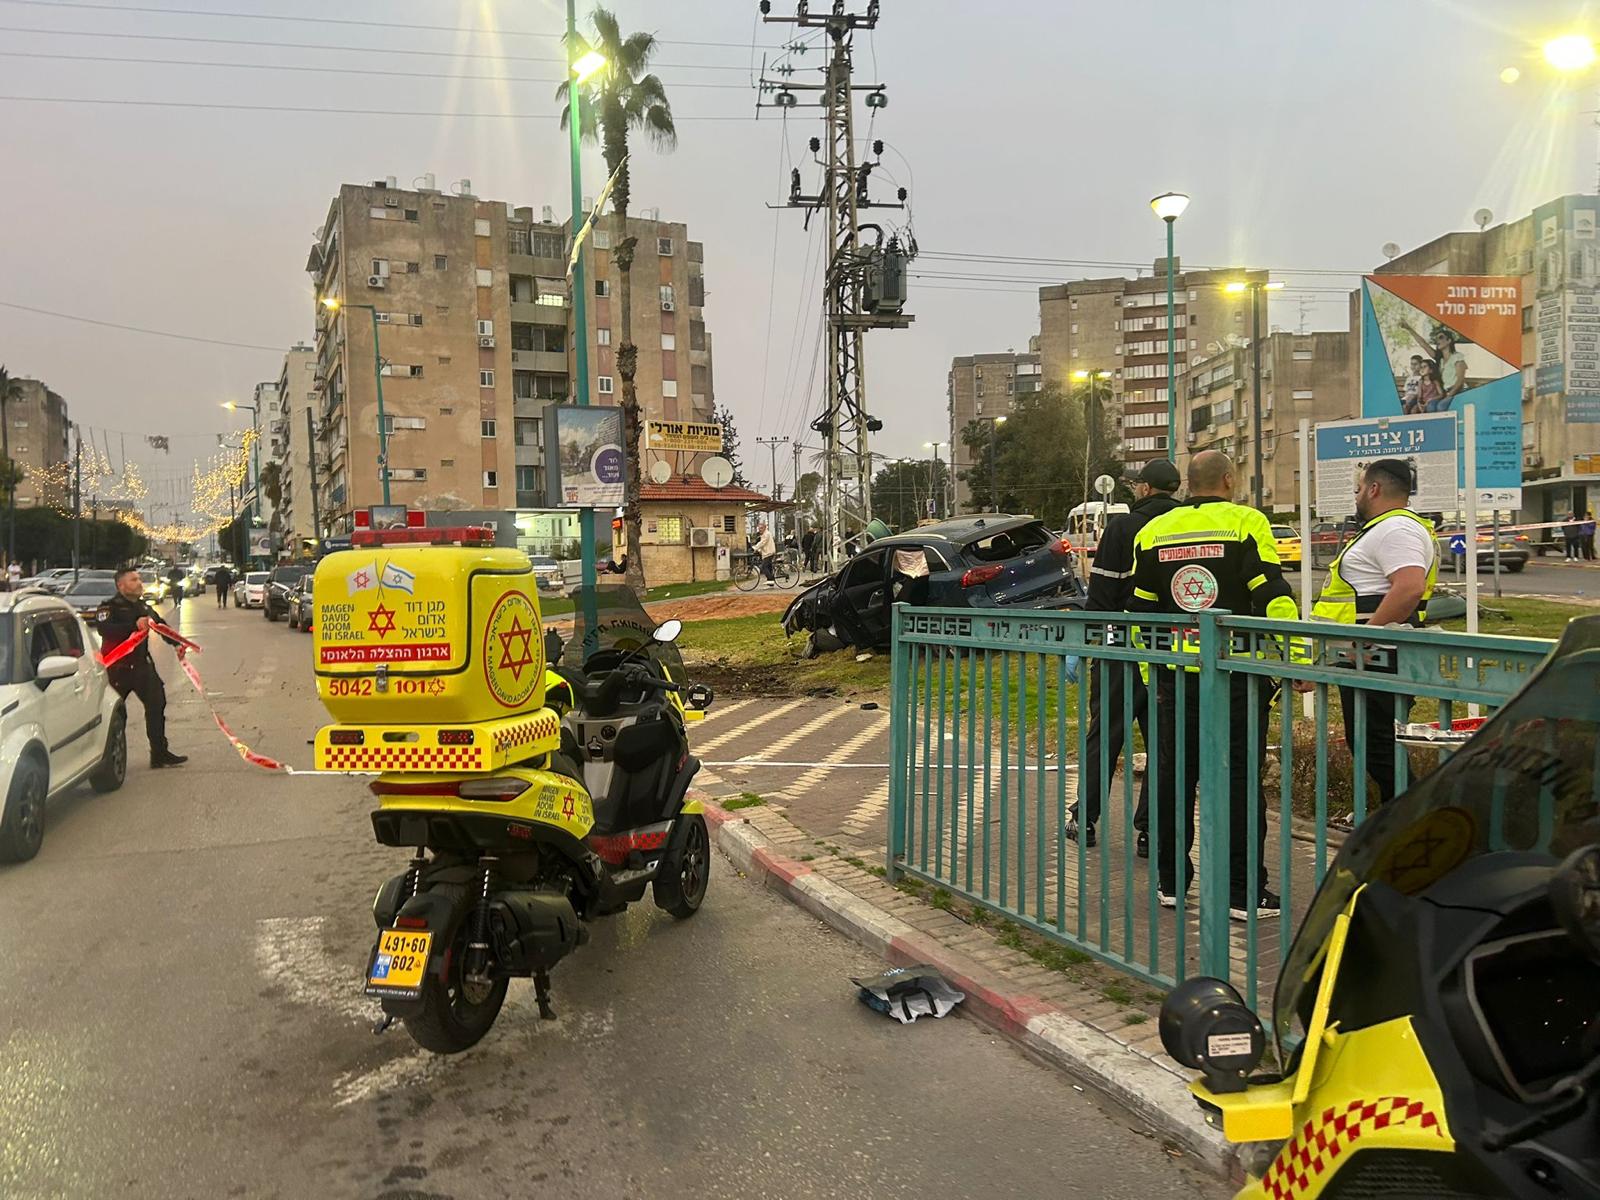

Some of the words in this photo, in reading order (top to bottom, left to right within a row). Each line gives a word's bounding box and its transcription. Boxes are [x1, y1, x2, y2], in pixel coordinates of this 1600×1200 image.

[1447, 286, 1477, 298] רחוב
[1480, 286, 1516, 298] חידוש
[1436, 300, 1466, 315] סולד
[1468, 303, 1516, 315] הנרייטה
[650, 422, 683, 434] אורלי
[687, 425, 720, 436] מוניות
[1344, 431, 1402, 448] ציבורי
[1407, 429, 1425, 446] גן
[1200, 546, 1222, 557] יחידת
[322, 604, 354, 612] MAGEN
[404, 602, 422, 612] דוד
[427, 600, 445, 614] מגן
[322, 614, 350, 622] DAVID
[417, 614, 446, 625] אדום
[322, 622, 351, 631] ADOM
[401, 626, 446, 638] בישראל
[985, 620, 1010, 638] לוד
[322, 632, 332, 640] IN
[334, 631, 365, 640] ISRAEL
[322, 648, 365, 660] הלאומי
[370, 648, 412, 659] ההצלה
[416, 646, 449, 659] ארגון
[329, 679, 372, 696] 5042
[395, 680, 426, 694] 101
[392, 955, 415, 972] 602
